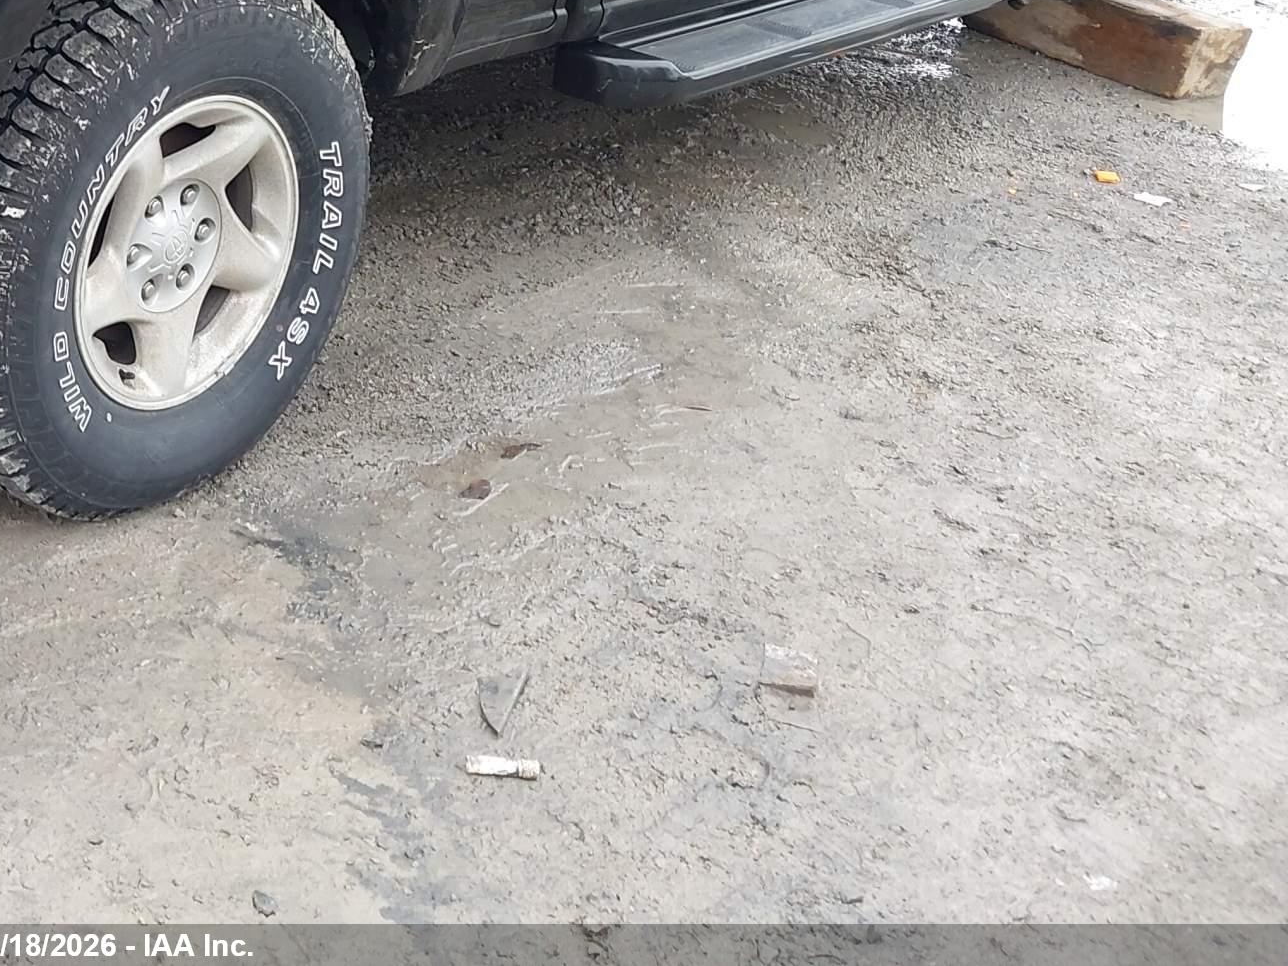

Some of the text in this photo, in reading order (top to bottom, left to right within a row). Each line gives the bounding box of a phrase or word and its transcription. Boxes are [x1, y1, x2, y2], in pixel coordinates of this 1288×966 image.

[52, 85, 171, 433] WILD COUNTRY
[268, 141, 345, 381] TRAIL 4SX
